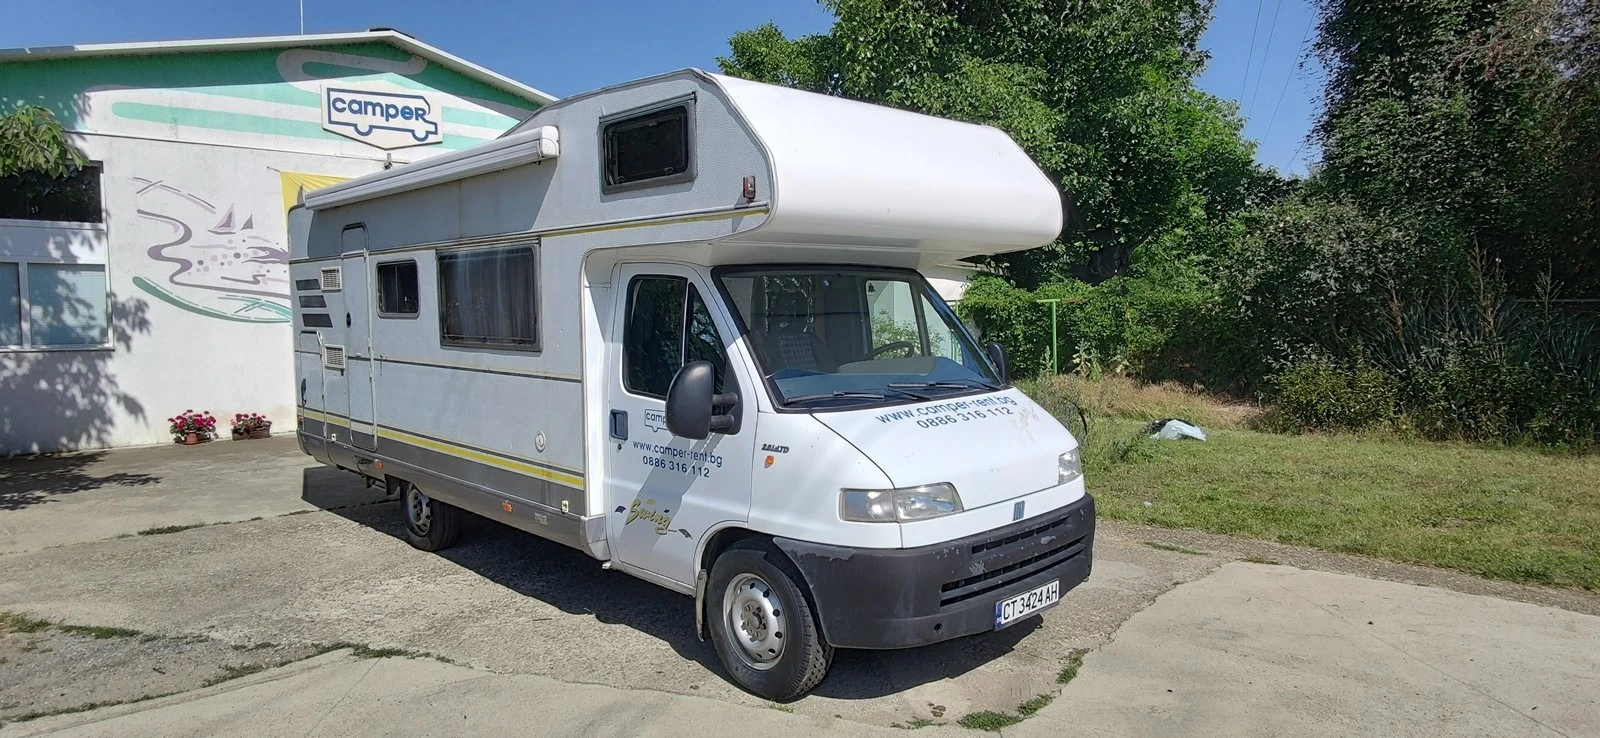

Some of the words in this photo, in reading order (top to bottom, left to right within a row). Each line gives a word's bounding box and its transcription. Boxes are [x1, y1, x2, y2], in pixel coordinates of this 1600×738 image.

[646, 412, 666, 426] camp
[875, 395, 1018, 424] www.camper-rent.bg
[916, 415, 957, 429] 0886
[958, 409, 986, 422] 316
[987, 406, 1014, 416] 112
[632, 440, 723, 468] www.camper-rent.bg
[642, 455, 666, 469] 0886
[668, 460, 688, 473] 316
[691, 465, 710, 478] 112
[625, 498, 671, 535] Swing
[1003, 599, 1018, 620] CT
[1018, 589, 1043, 614] 3424
[1044, 582, 1058, 604] AH
